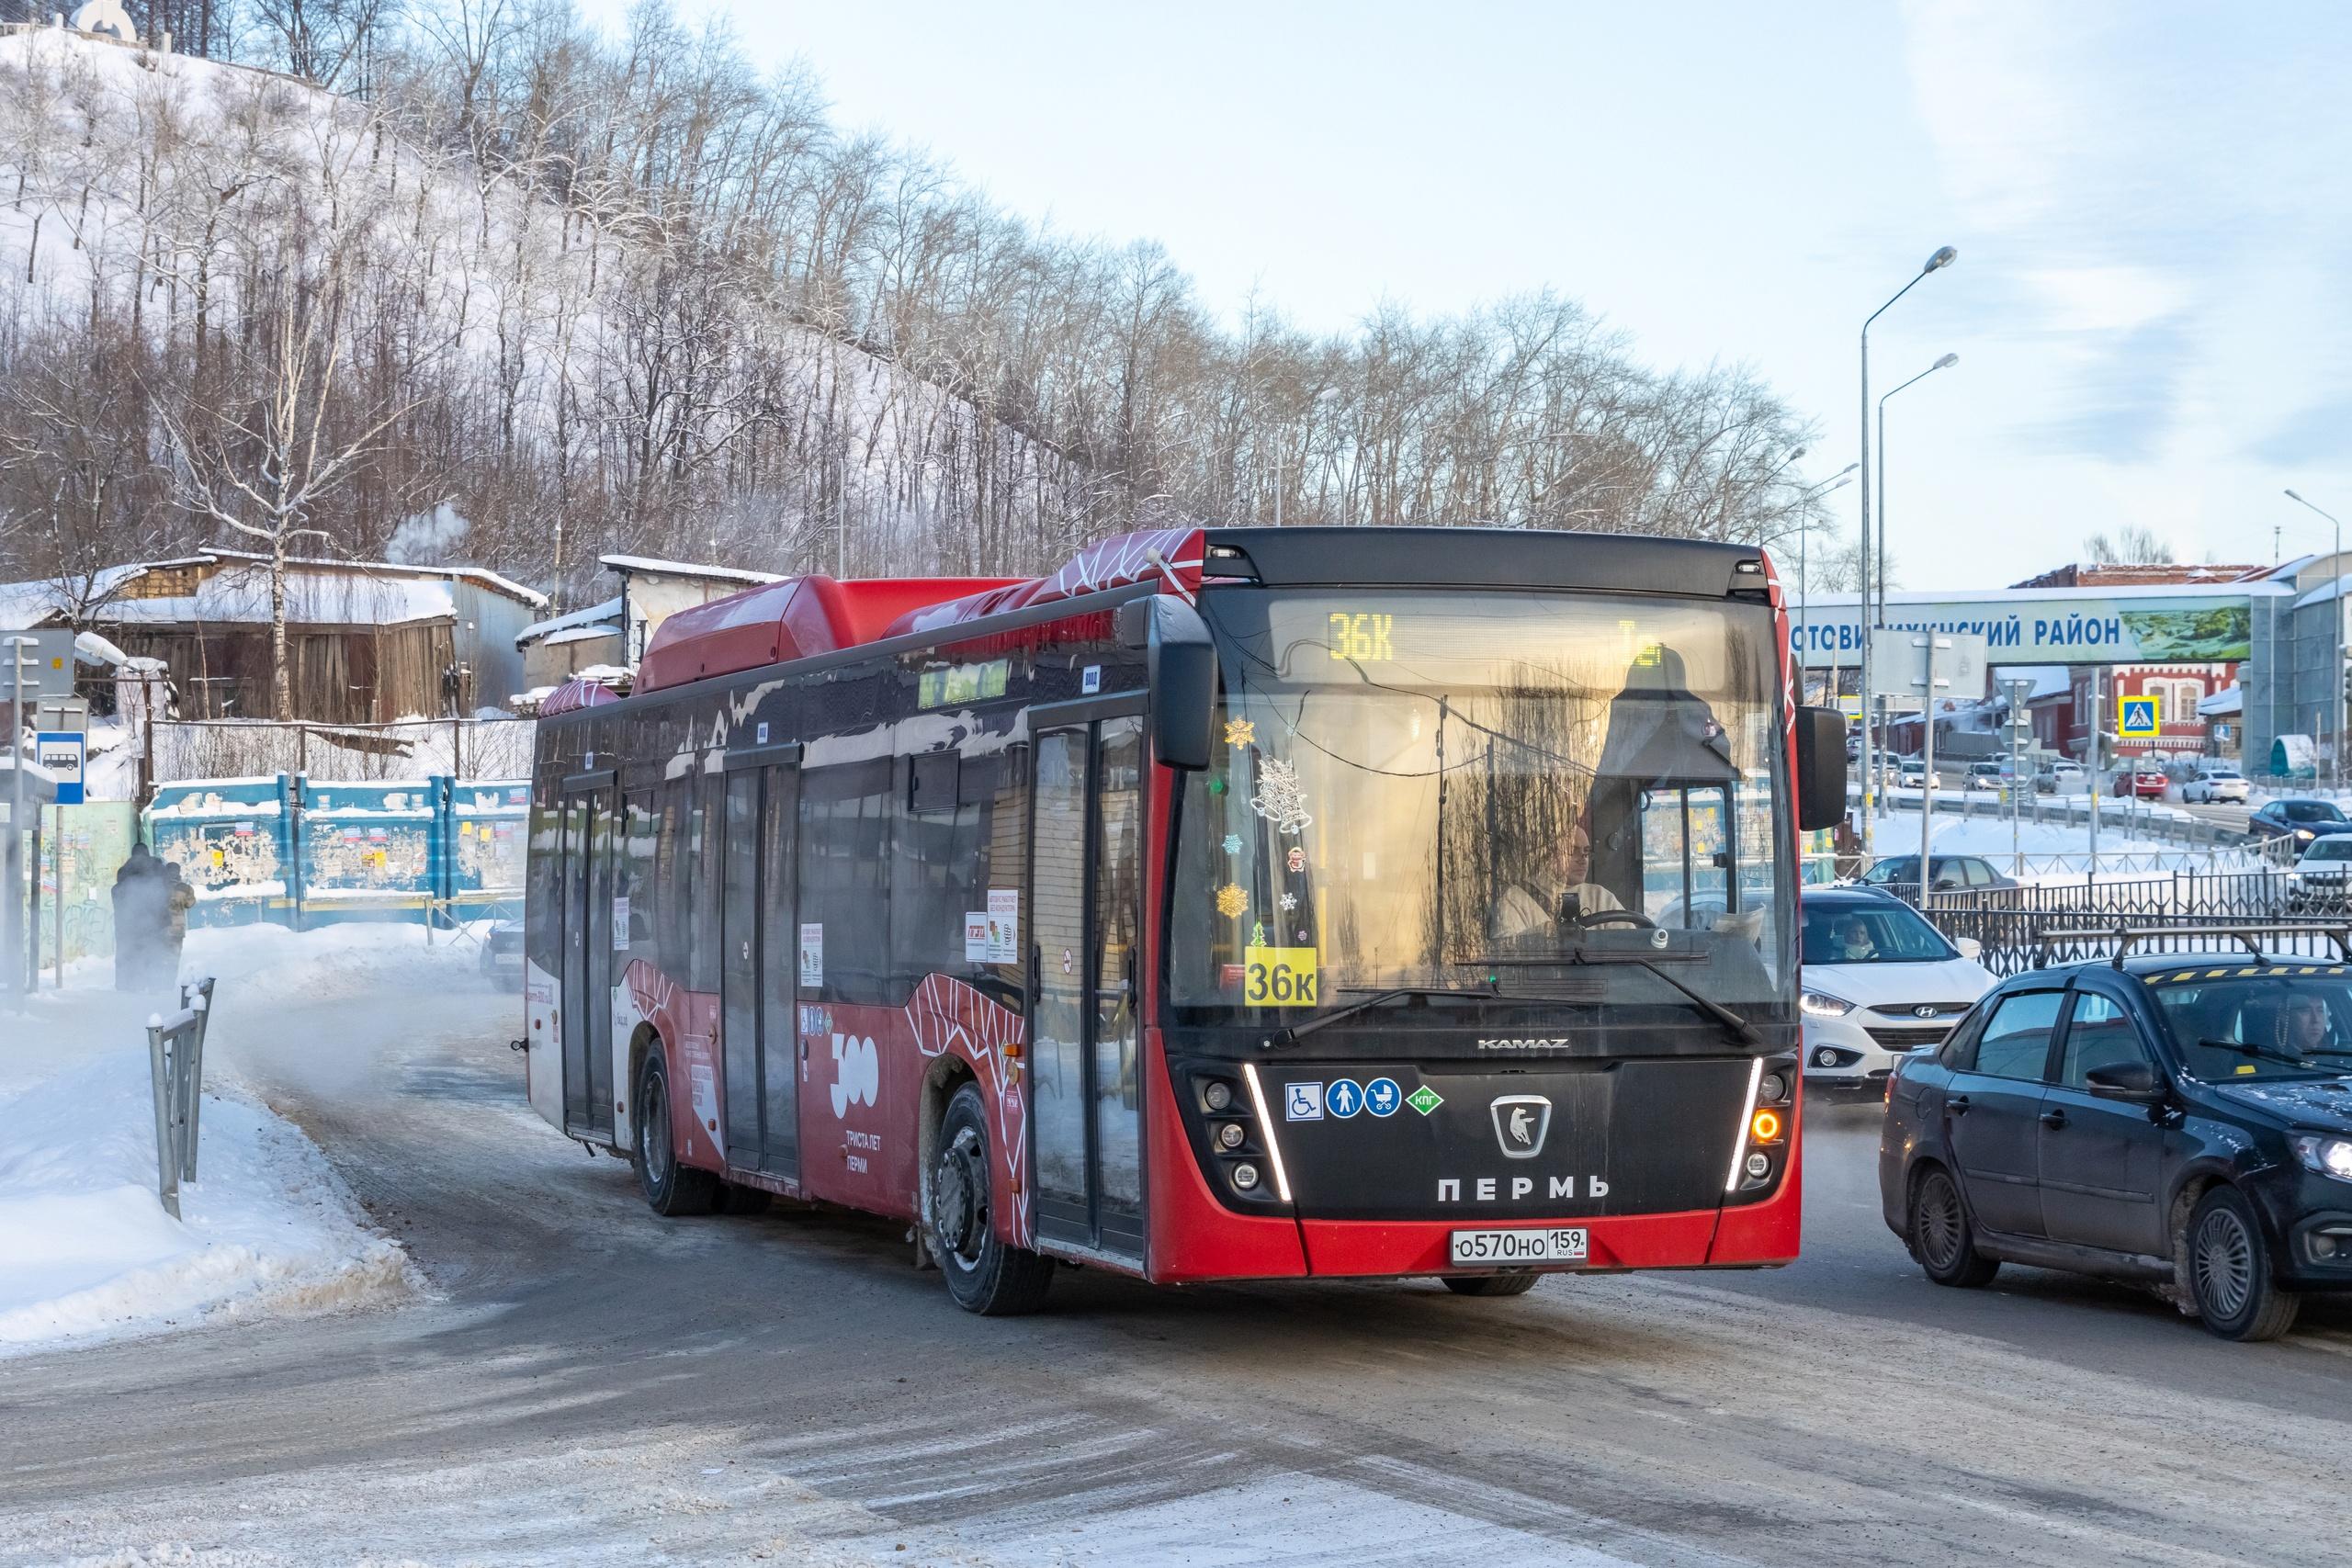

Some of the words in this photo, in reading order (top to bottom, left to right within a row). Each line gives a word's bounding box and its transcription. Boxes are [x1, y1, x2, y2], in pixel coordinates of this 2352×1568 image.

[2034, 613, 2120, 646] РАЙОН
[1248, 963, 1315, 1001] 36к
[1477, 1039, 1569, 1049] KAMAZ
[830, 1032, 879, 1120] 300
[1415, 1095, 1435, 1105] КПГ
[845, 1130, 869, 1149] ТРИСТА
[869, 1134, 881, 1151] ЛЕТ
[846, 1155, 868, 1174] ПЕРМИ
[1438, 1175, 1610, 1201] ПЕРМЬ
[1459, 1234, 1545, 1258] О570НО
[1550, 1231, 1581, 1249] 159
